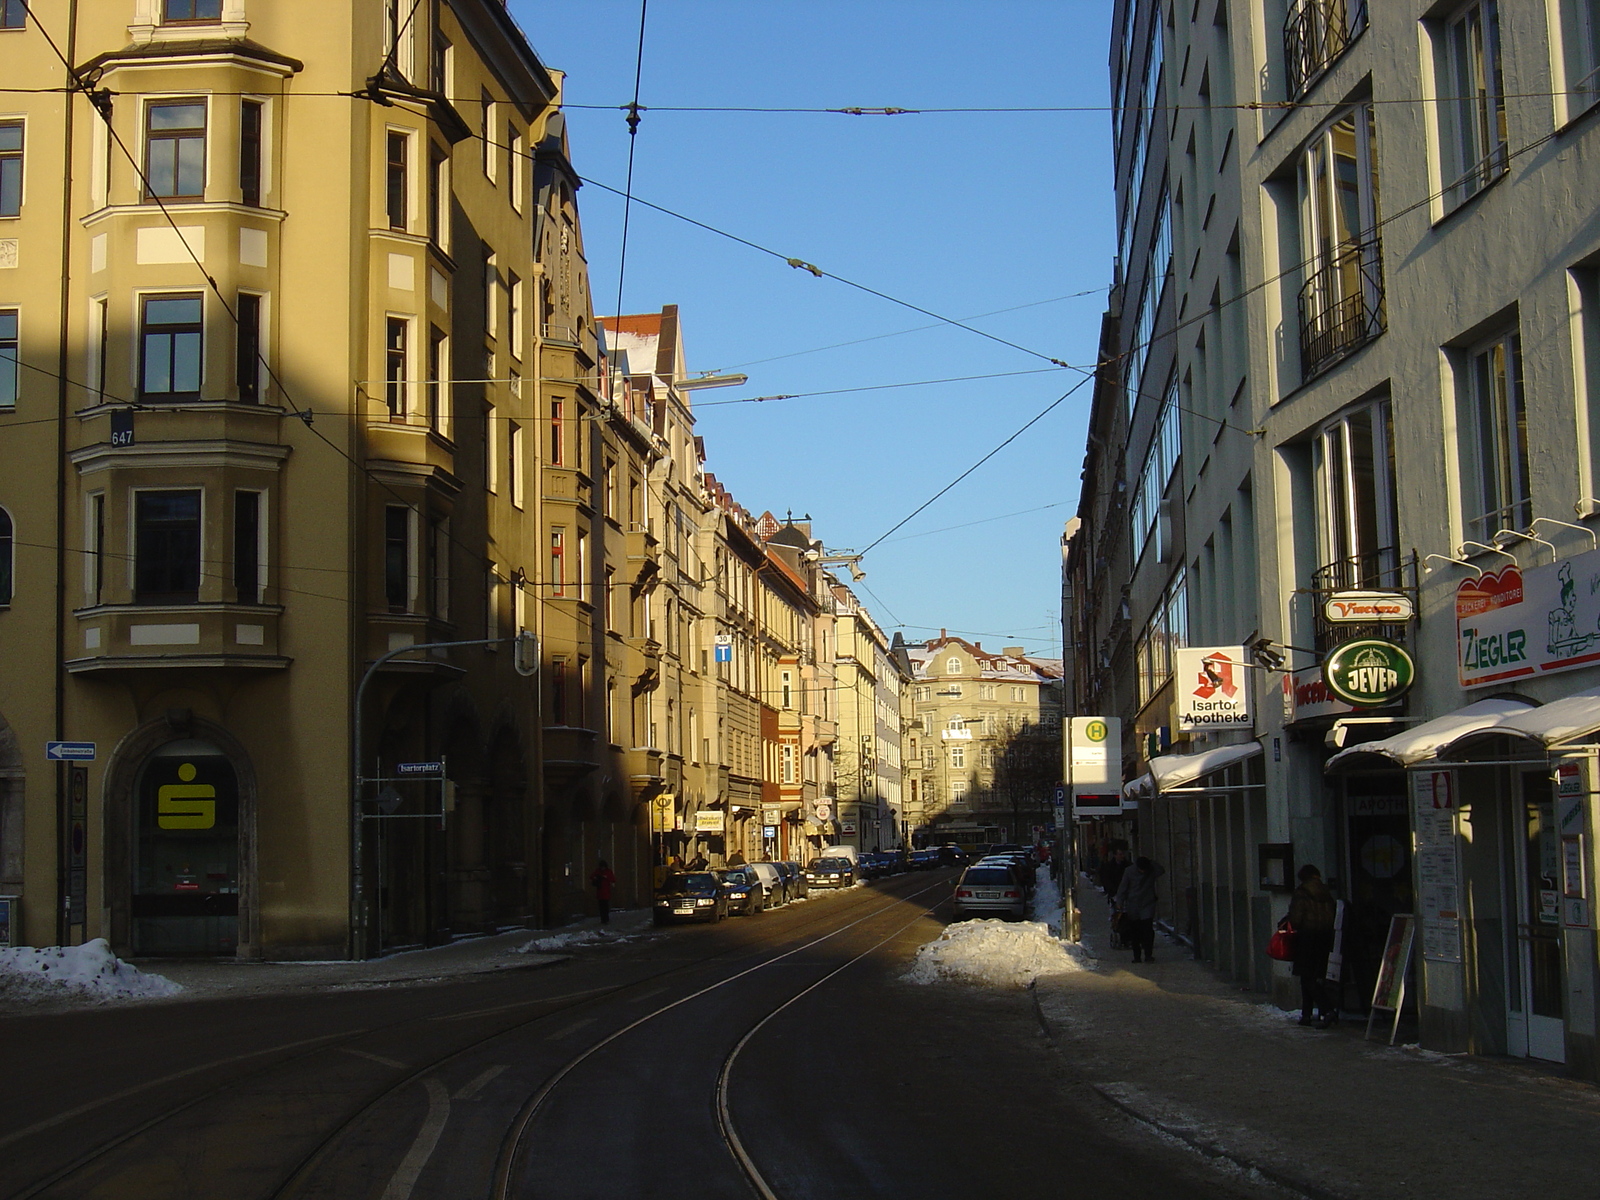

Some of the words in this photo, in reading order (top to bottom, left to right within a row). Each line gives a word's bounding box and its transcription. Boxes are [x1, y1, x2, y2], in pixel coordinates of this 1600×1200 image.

[112, 430, 133, 445] 647
[718, 646, 729, 661] T
[1348, 667, 1398, 693] JEVER
[1192, 699, 1238, 711] Isartor
[1184, 712, 1249, 727] Apotheke
[1091, 725, 1103, 738] H
[400, 764, 439, 772] Isartorplatz
[1056, 790, 1064, 804] P
